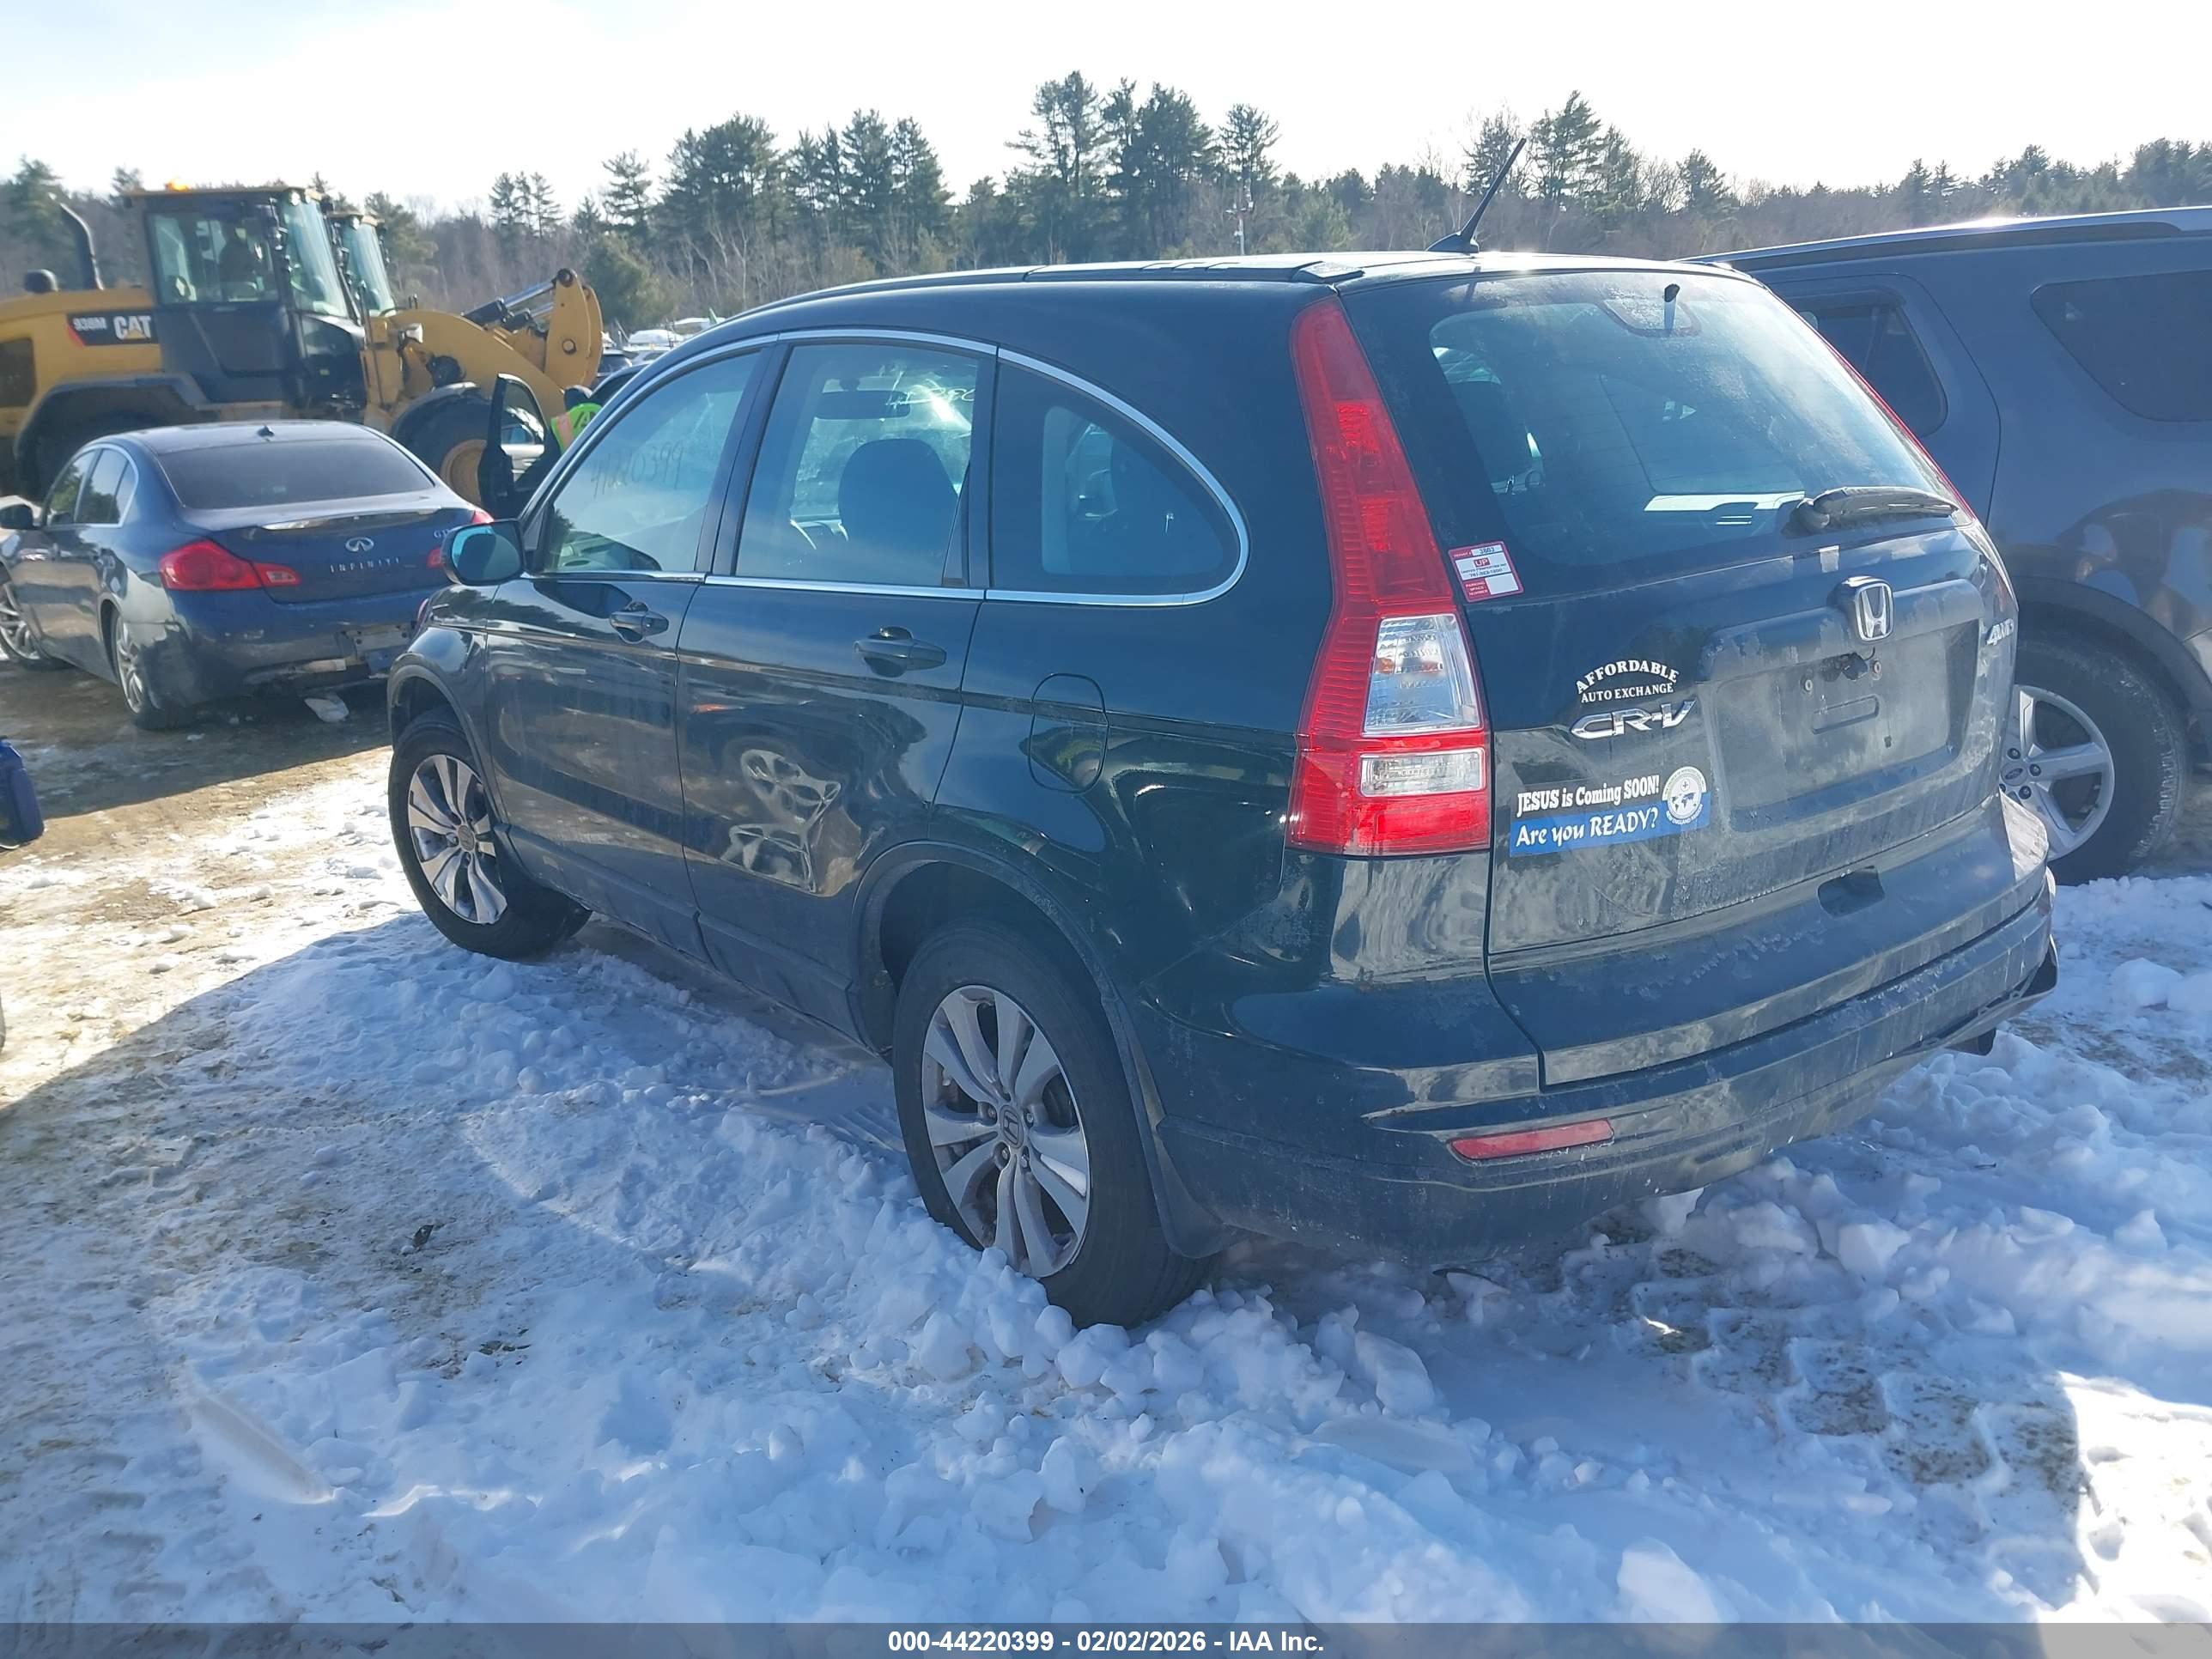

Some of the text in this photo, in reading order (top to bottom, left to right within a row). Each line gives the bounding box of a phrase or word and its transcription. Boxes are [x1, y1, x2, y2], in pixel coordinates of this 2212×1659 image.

[112, 315, 152, 341] CAT
[1474, 558, 1488, 567] UP
[1576, 659, 1680, 694] AFFORDABLE
[1581, 683, 1674, 703] AUTO EXCHANGE
[1570, 698, 1698, 740] CR-V
[1516, 788, 1560, 817] JESUS
[1561, 787, 1573, 807] is
[1575, 782, 1622, 805] Coming
[1623, 775, 1660, 799] SOON!
[1516, 806, 1659, 847] Are you READY?
